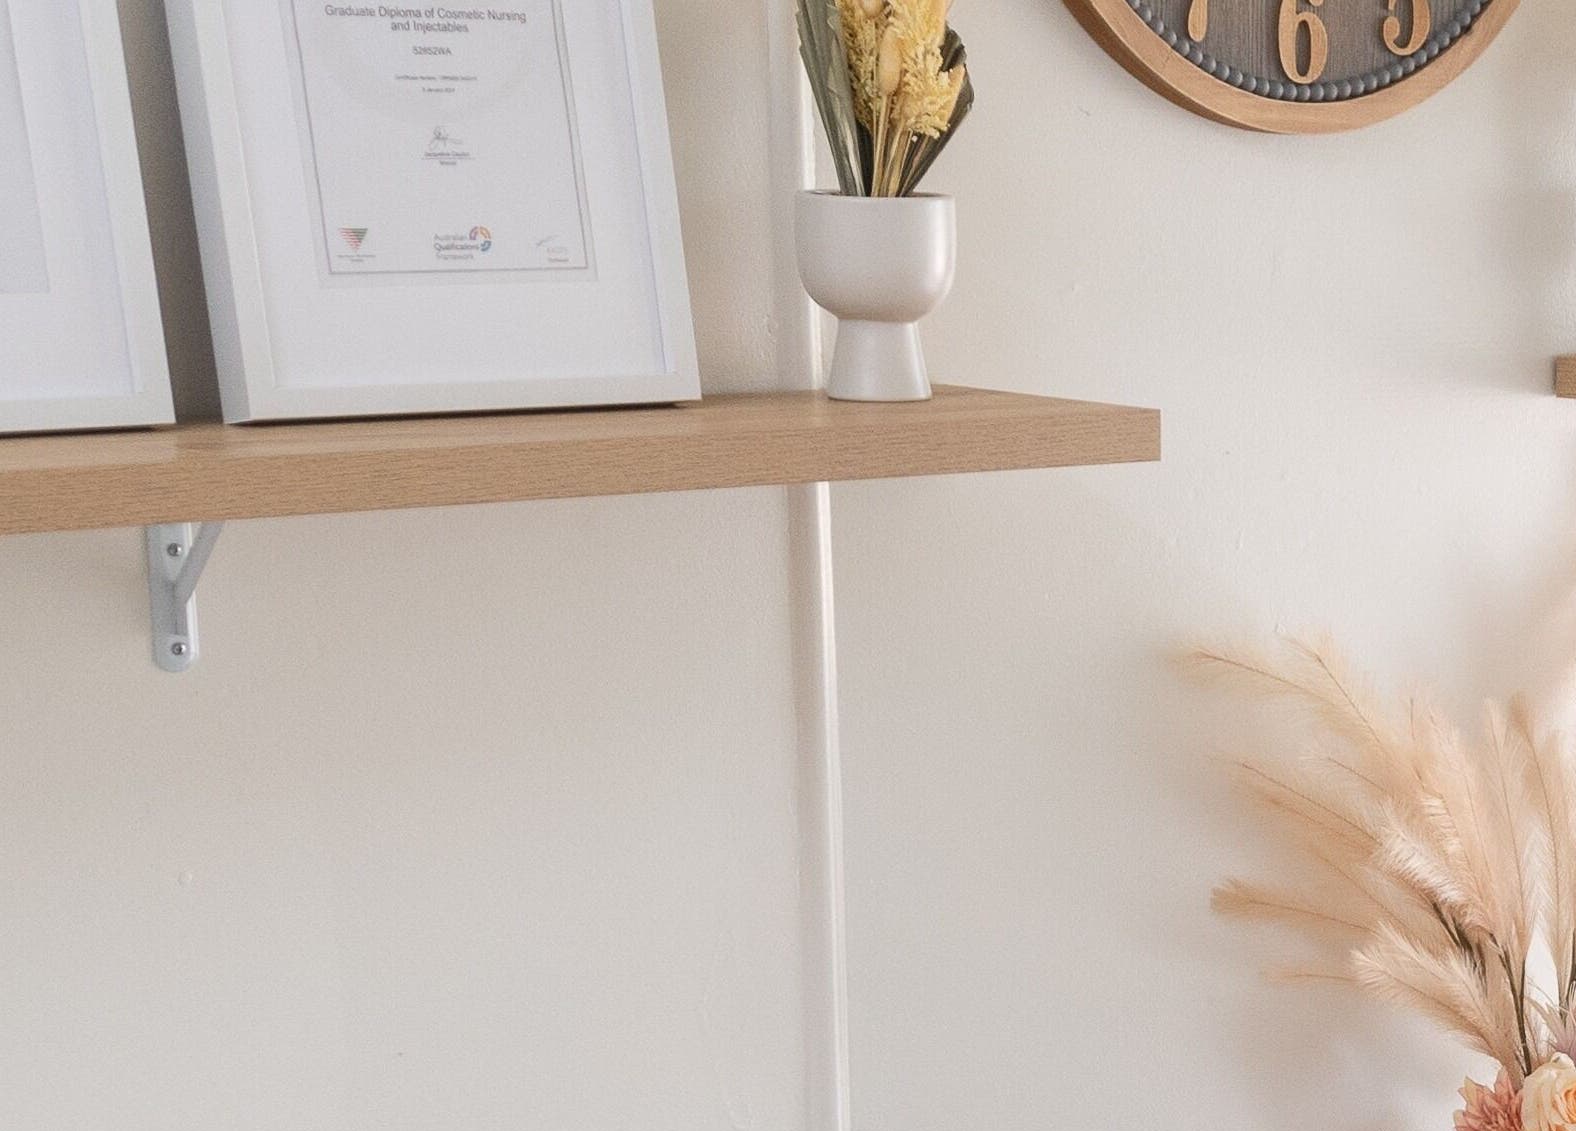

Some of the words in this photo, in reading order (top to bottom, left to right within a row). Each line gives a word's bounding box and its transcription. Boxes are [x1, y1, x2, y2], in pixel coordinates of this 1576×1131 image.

[325, 5, 375, 17] Graduate
[378, 7, 421, 19] Diploma
[425, 8, 434, 18] of
[437, 8, 485, 20] Cosmetic
[487, 10, 527, 24] Nursing
[391, 21, 410, 31] and
[413, 22, 469, 34] Injectables
[1278, 0, 1328, 84] 6
